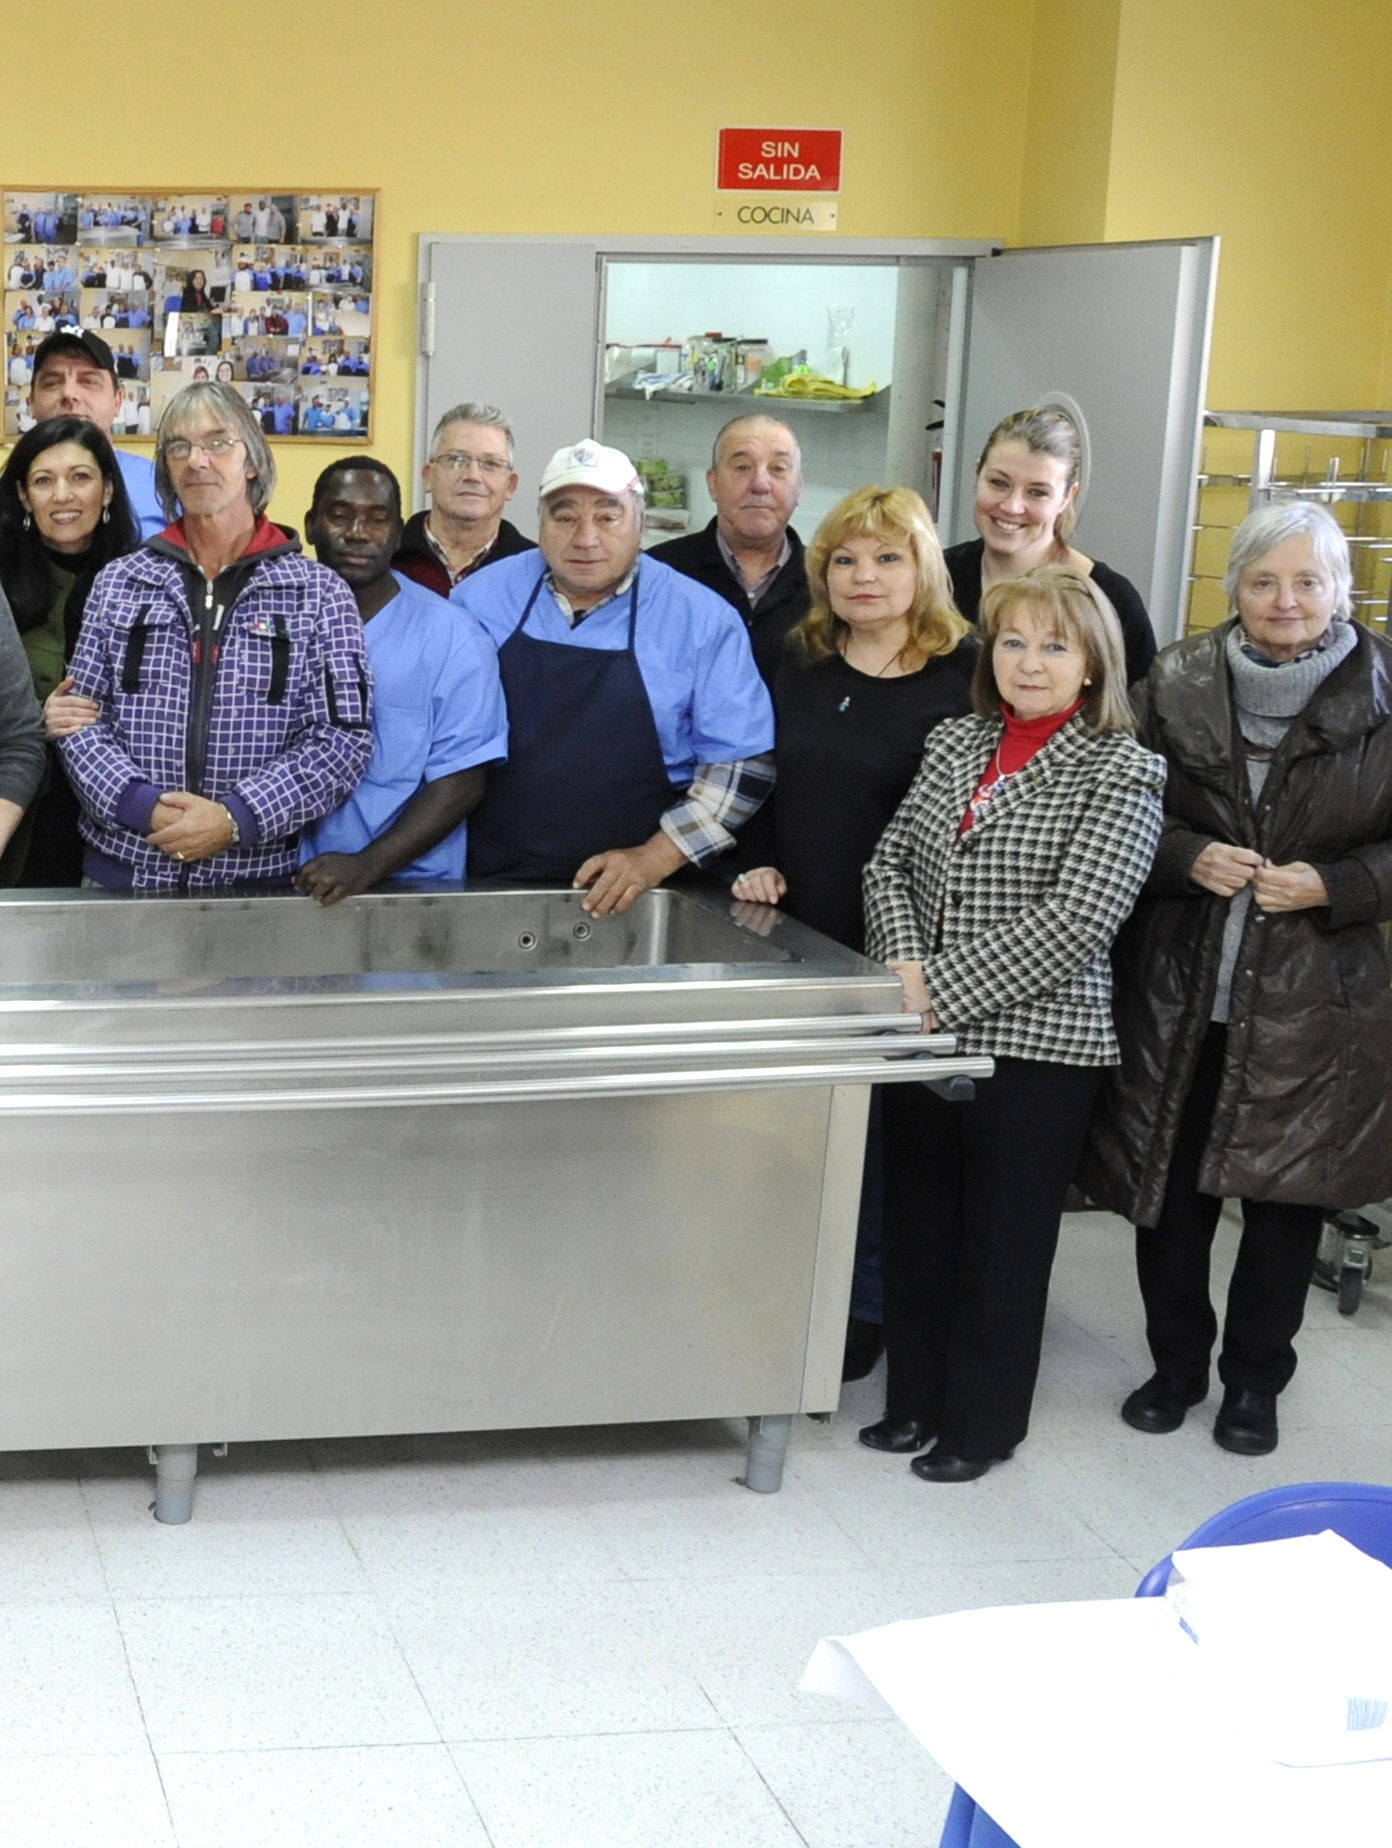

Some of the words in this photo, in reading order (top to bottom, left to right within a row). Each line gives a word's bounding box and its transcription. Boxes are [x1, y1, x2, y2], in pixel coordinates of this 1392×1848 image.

[761, 141, 800, 158] SIN
[738, 162, 821, 180] SALIDA
[737, 205, 814, 224] COCINA
